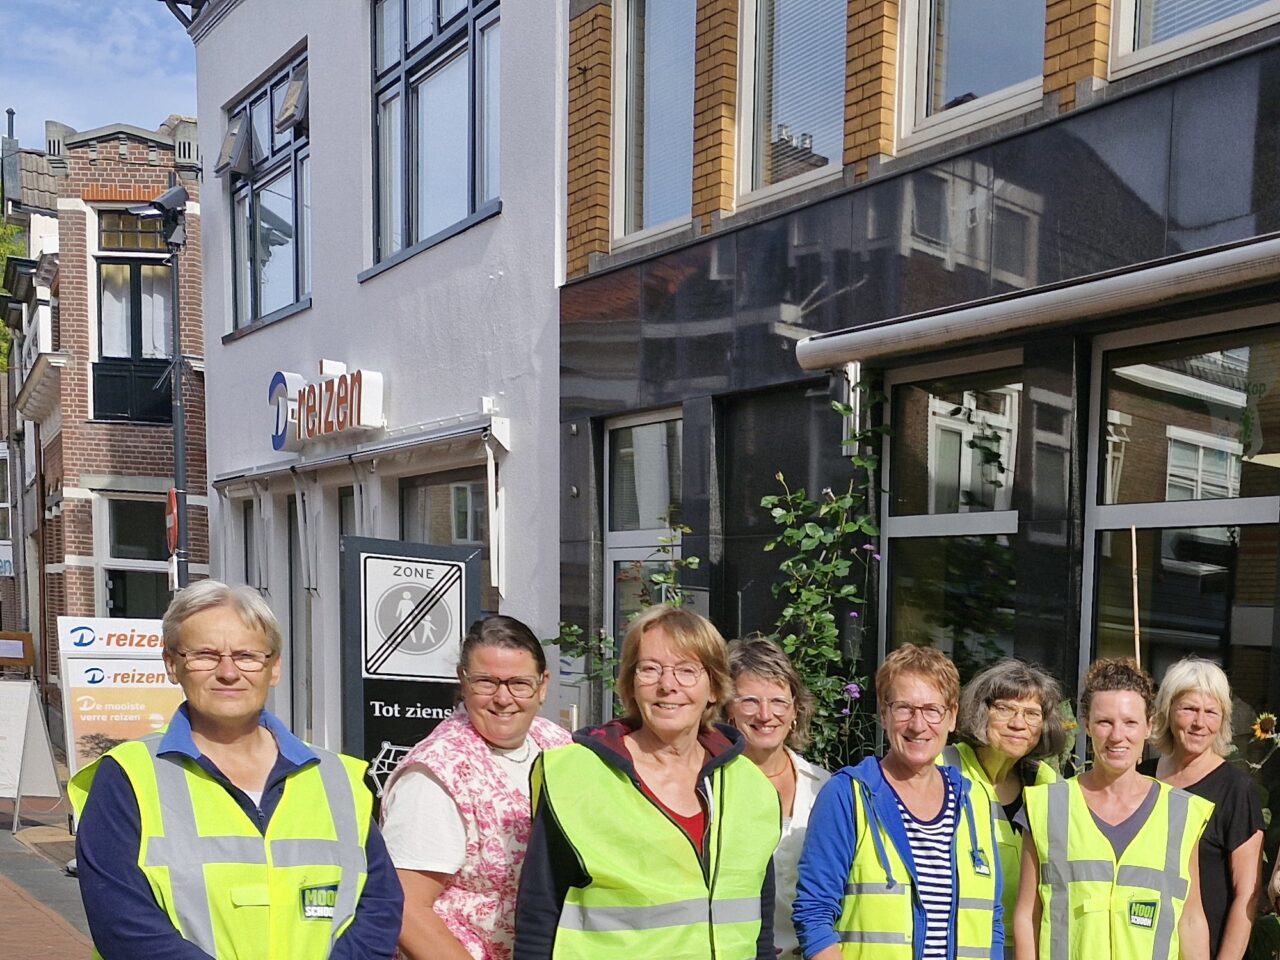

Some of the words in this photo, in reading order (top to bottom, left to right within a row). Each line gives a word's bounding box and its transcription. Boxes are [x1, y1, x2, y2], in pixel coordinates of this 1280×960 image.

[393, 566, 434, 579] ZONE
[104, 702, 146, 711] mooiste
[370, 701, 401, 717] Tot
[405, 703, 455, 719] ziens
[80, 713, 107, 721] verre
[110, 712, 141, 721] reizen
[305, 888, 337, 906] MOO
[1131, 902, 1155, 918] MOOI
